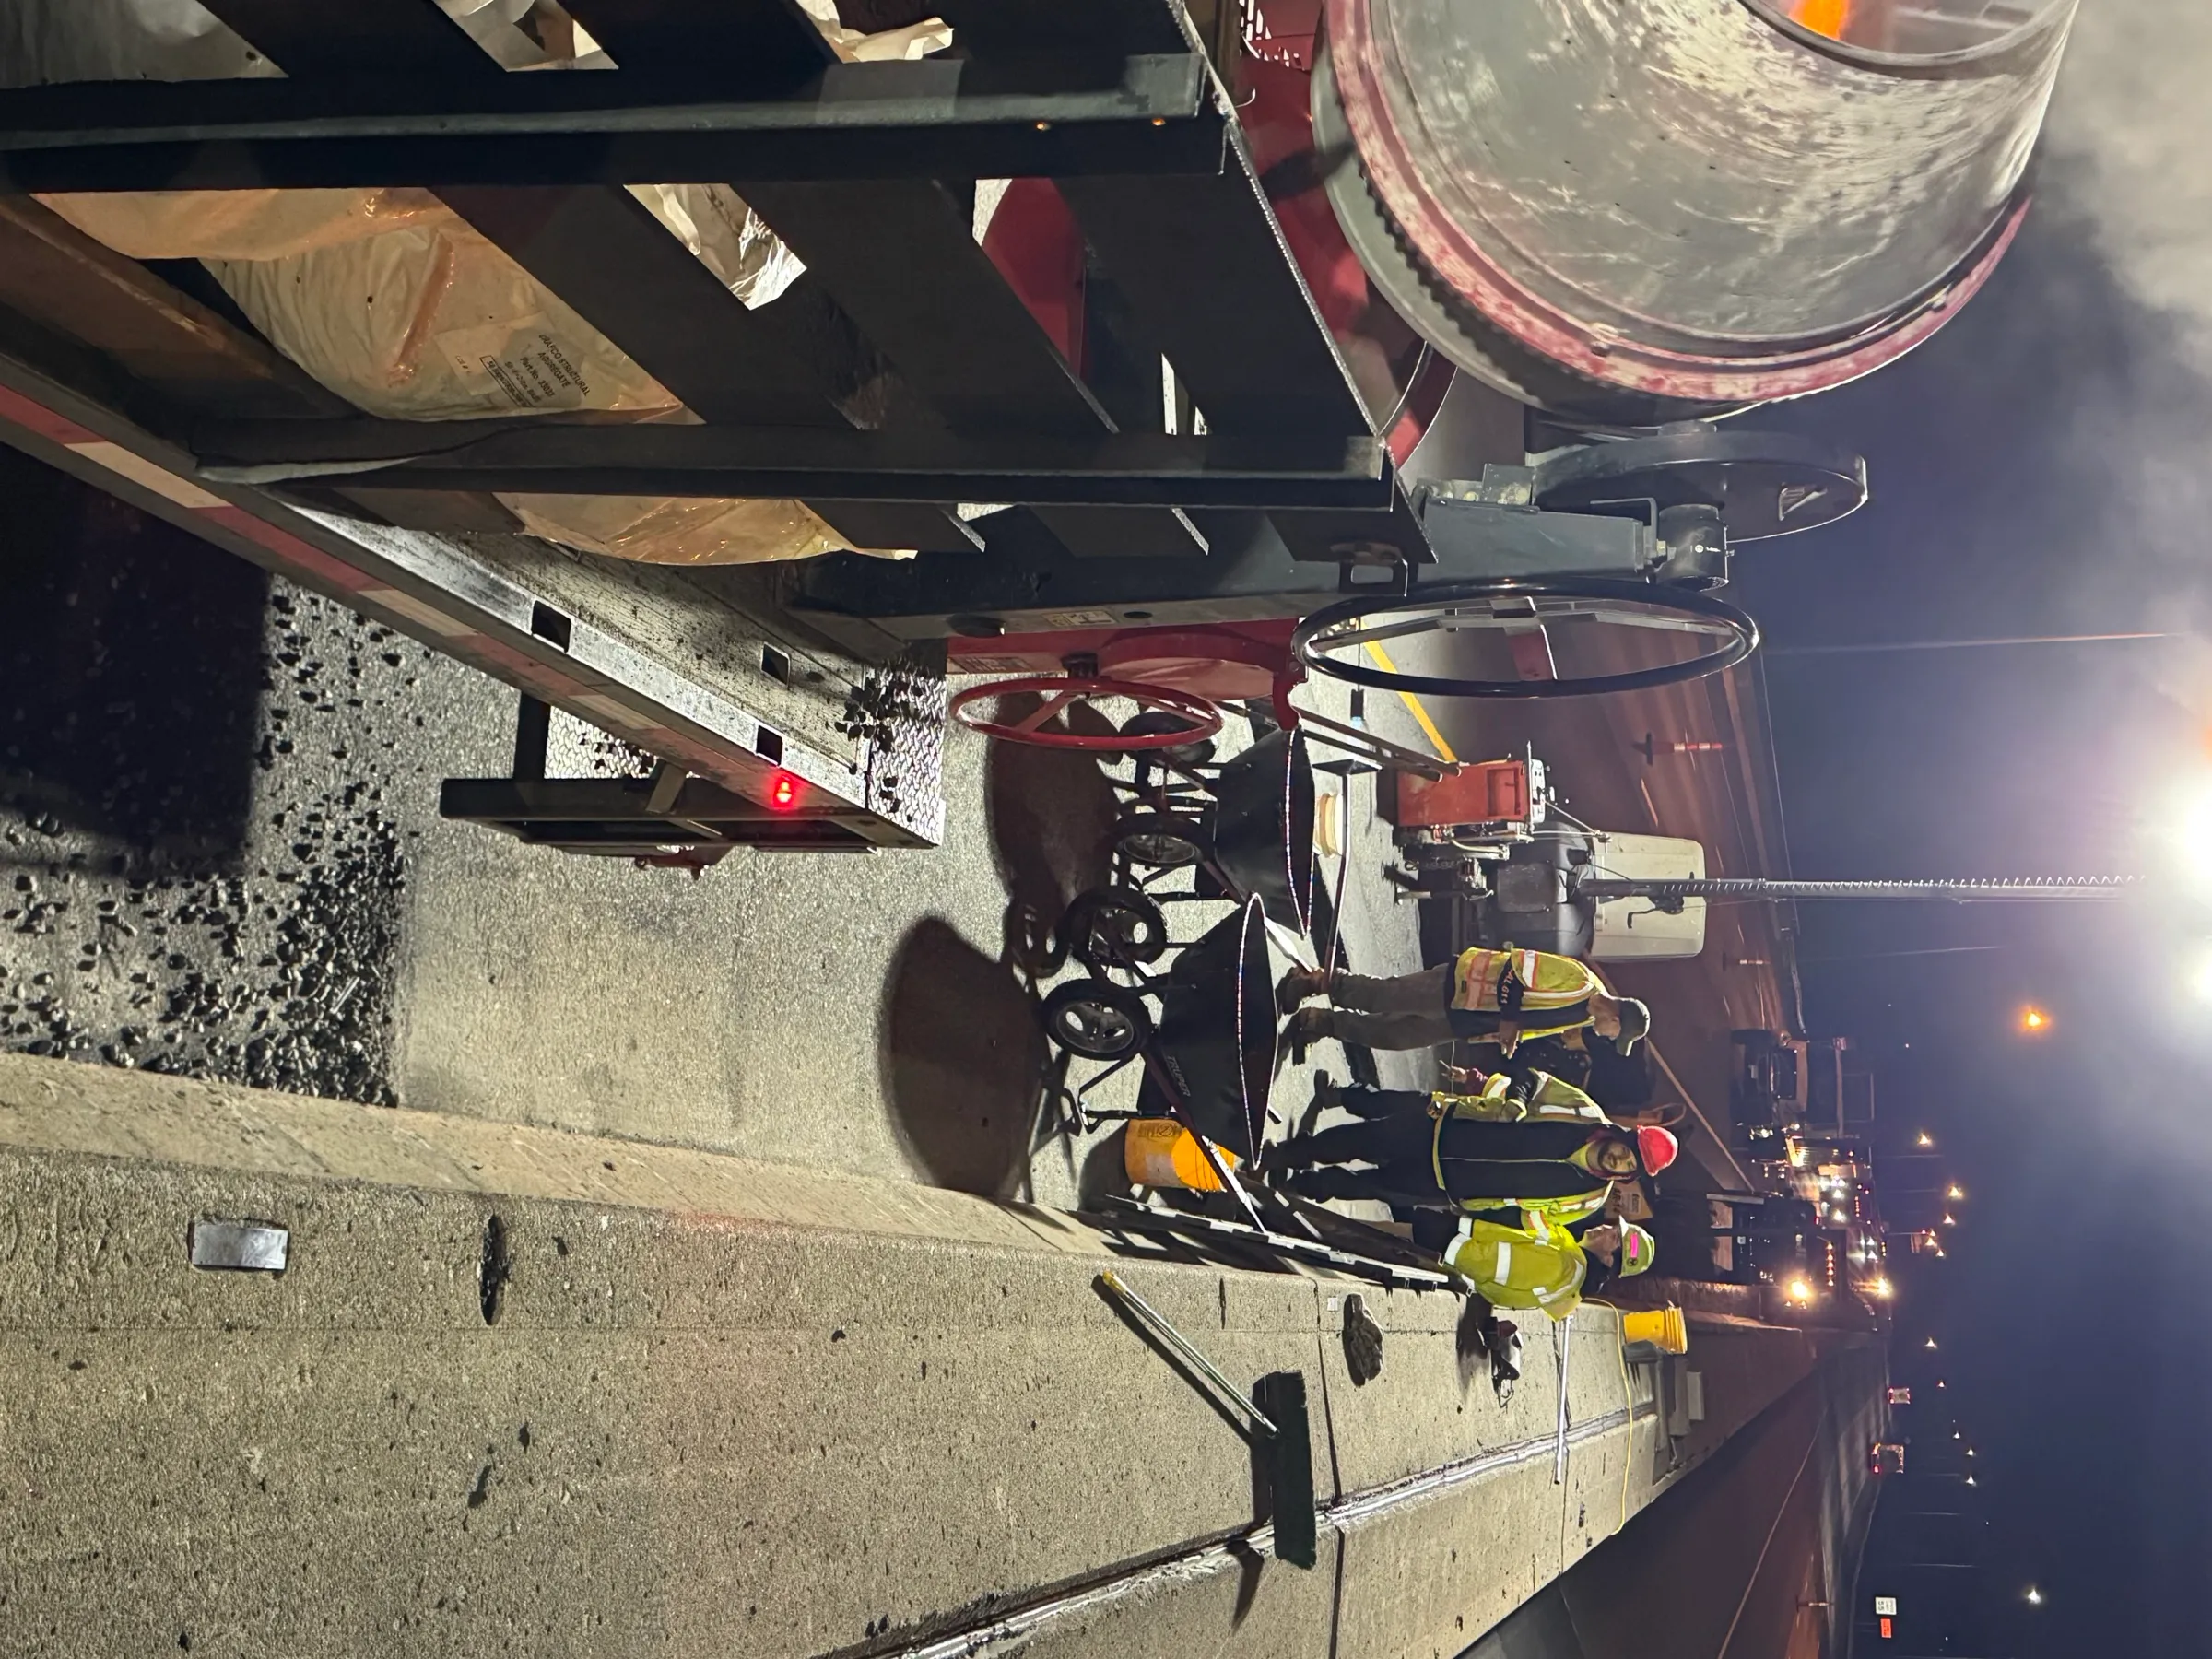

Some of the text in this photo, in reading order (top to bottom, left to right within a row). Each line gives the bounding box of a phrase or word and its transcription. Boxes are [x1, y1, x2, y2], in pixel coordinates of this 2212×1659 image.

[520, 357, 533, 371] Part
[537, 352, 570, 389] AGGREGATE
[558, 359, 590, 396] STRUCTURAL
[1167, 1056, 1191, 1097] TRUPER
[1878, 1601, 1884, 1611] 55
